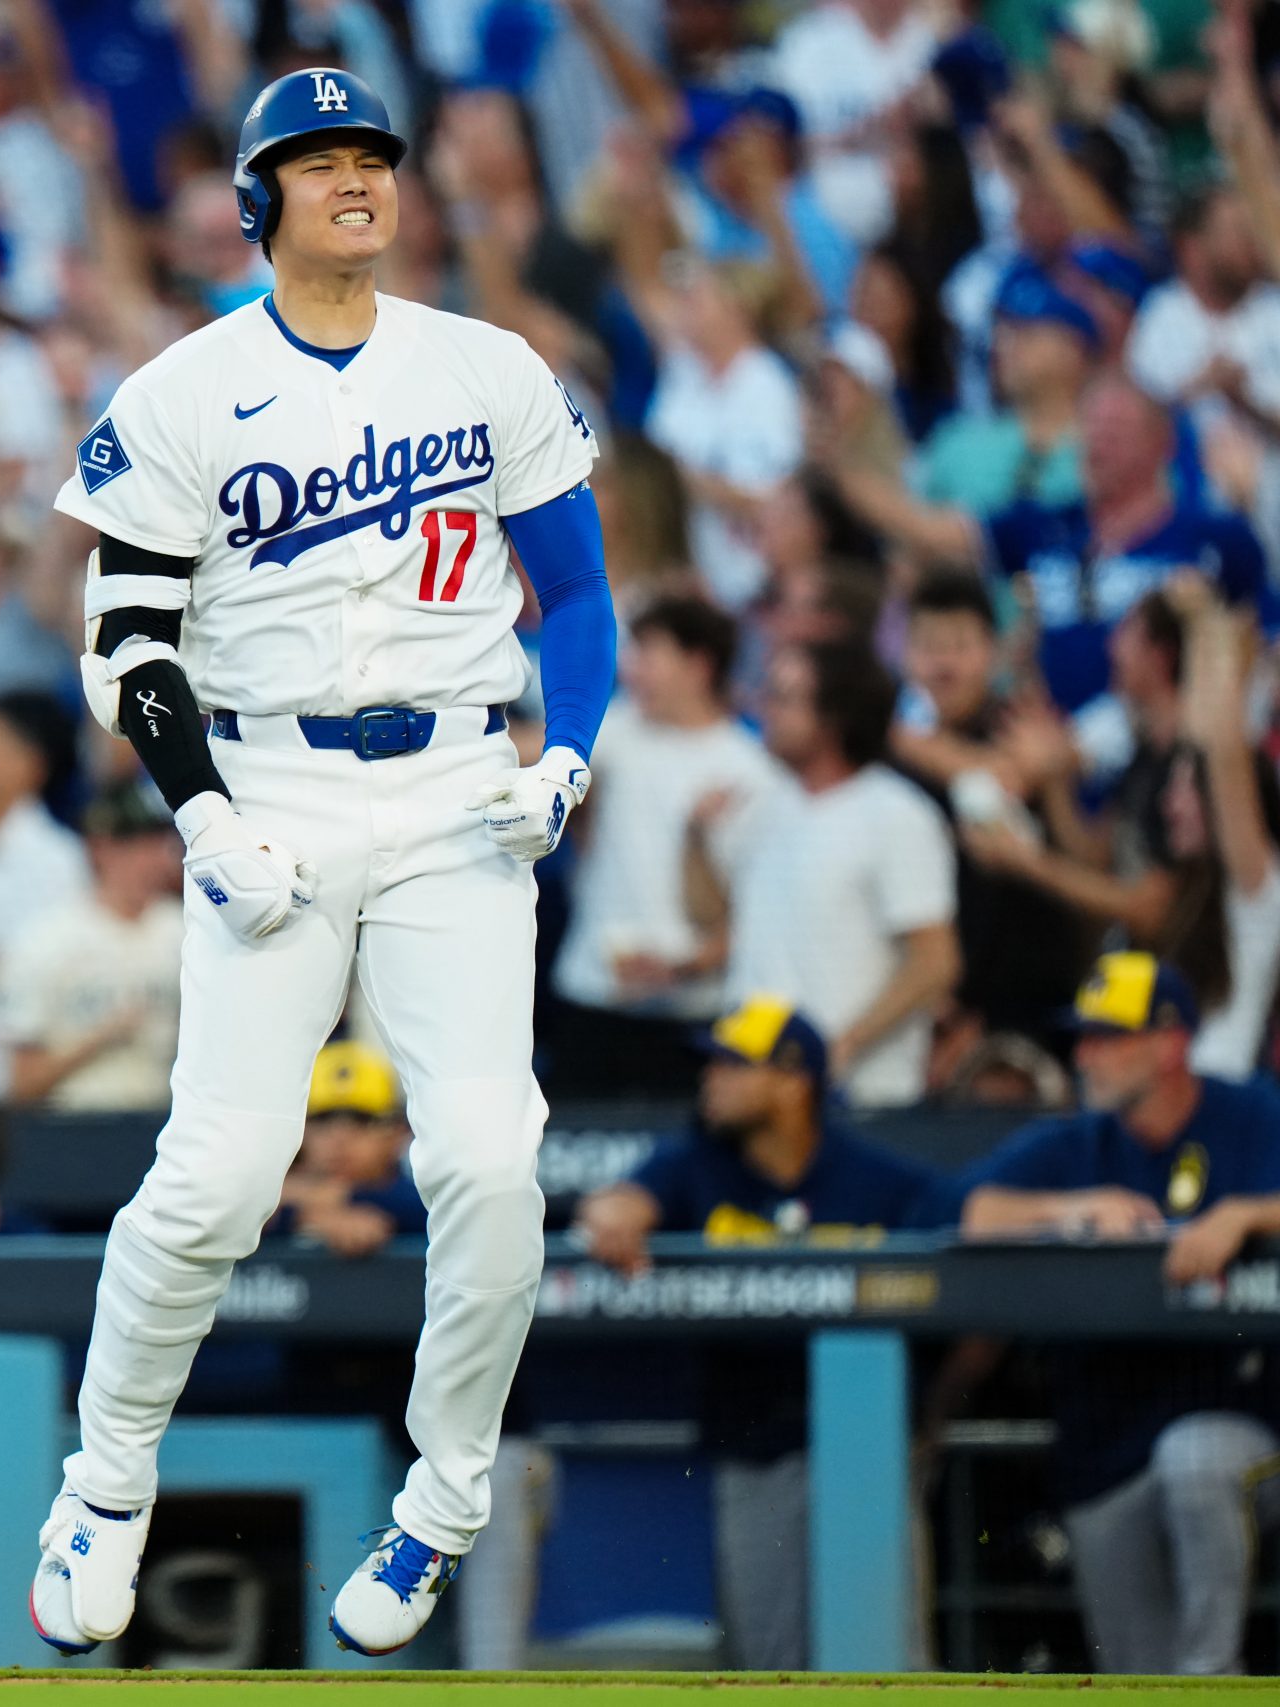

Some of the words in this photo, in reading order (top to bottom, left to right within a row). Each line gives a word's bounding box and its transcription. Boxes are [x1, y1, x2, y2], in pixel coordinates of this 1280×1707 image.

[310, 73, 348, 112] LA
[90, 437, 113, 464] G
[219, 423, 494, 548] Dodgers
[418, 511, 477, 602] 17
[489, 815, 526, 826] balance
